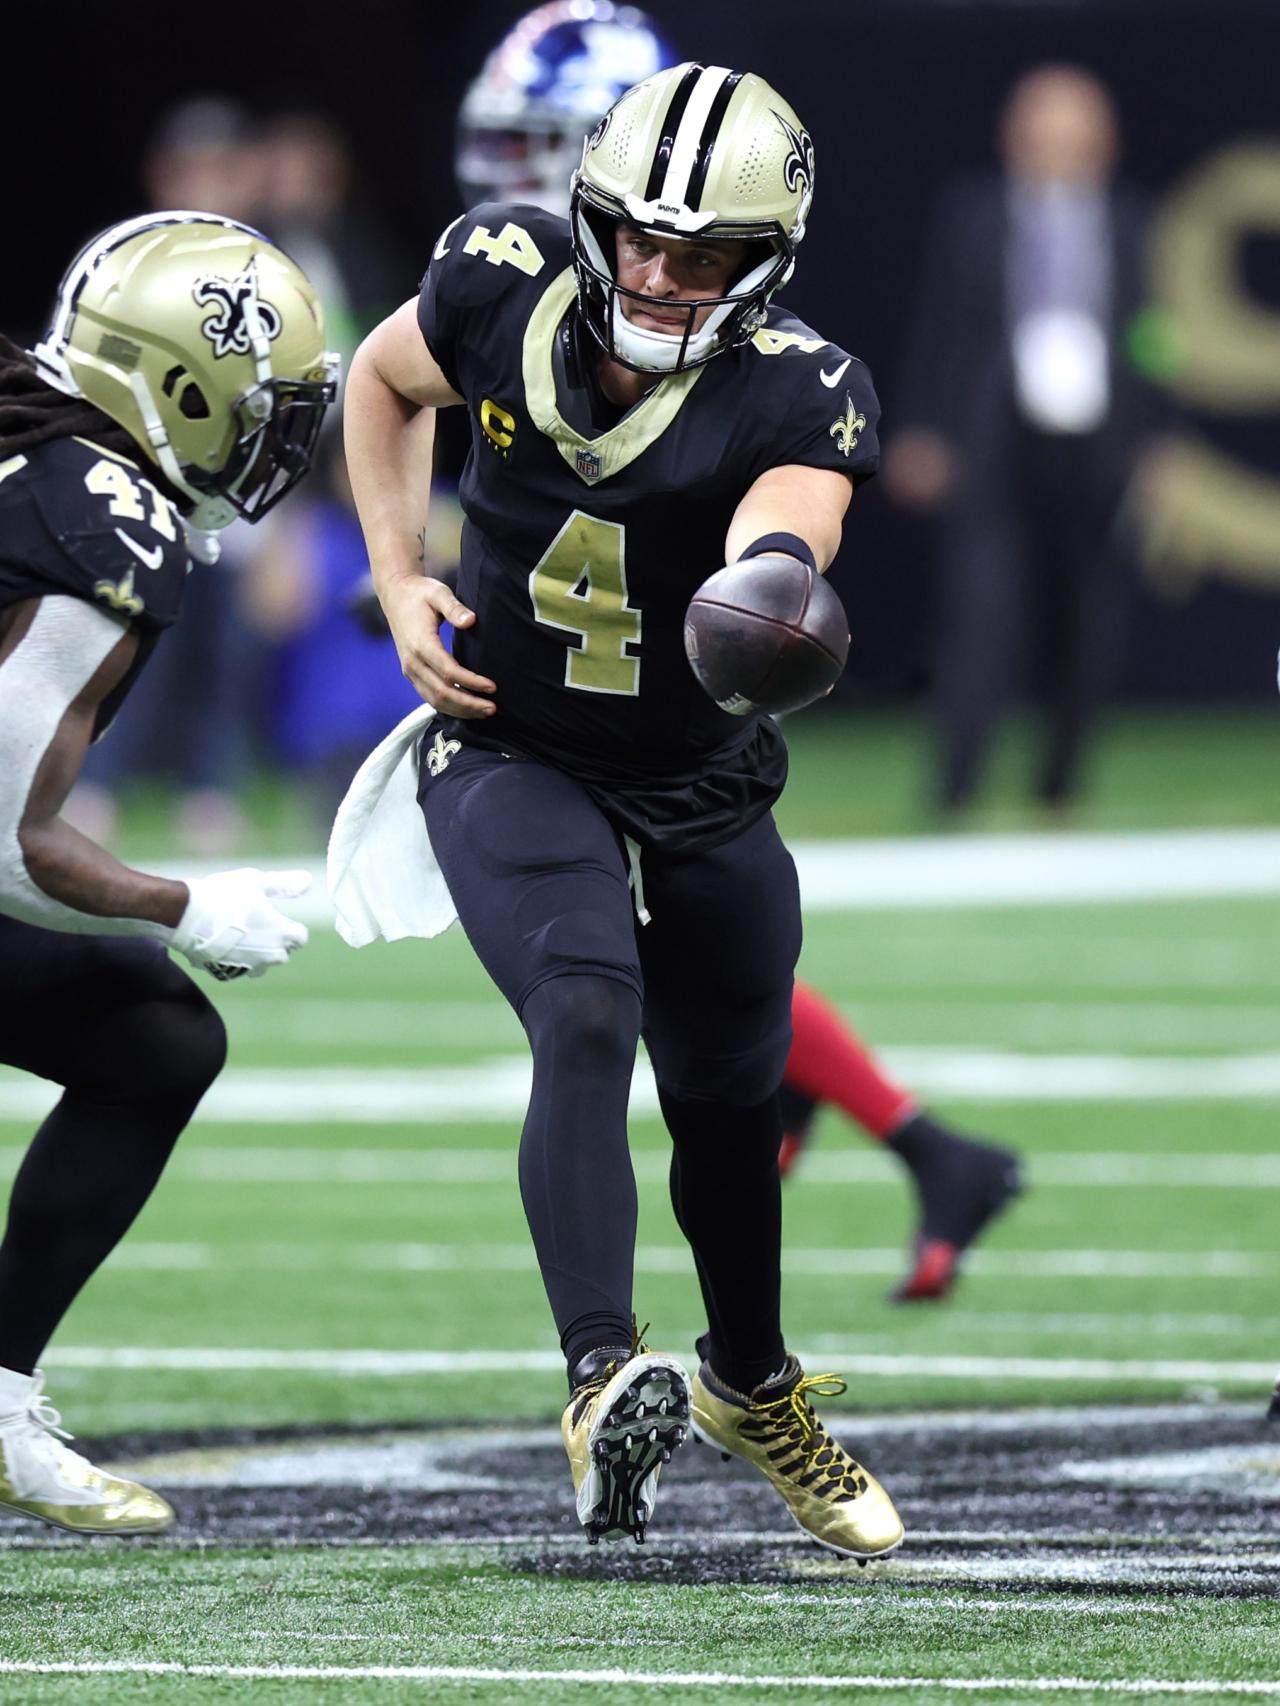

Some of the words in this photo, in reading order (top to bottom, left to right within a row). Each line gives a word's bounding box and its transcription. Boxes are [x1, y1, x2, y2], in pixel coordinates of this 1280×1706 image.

[657, 203, 680, 215] SAINTS
[462, 222, 546, 277] 4
[750, 327, 830, 355] 4
[480, 399, 516, 448] C
[577, 459, 600, 478] NFL
[84, 459, 177, 542] 41
[529, 509, 642, 697] 4
